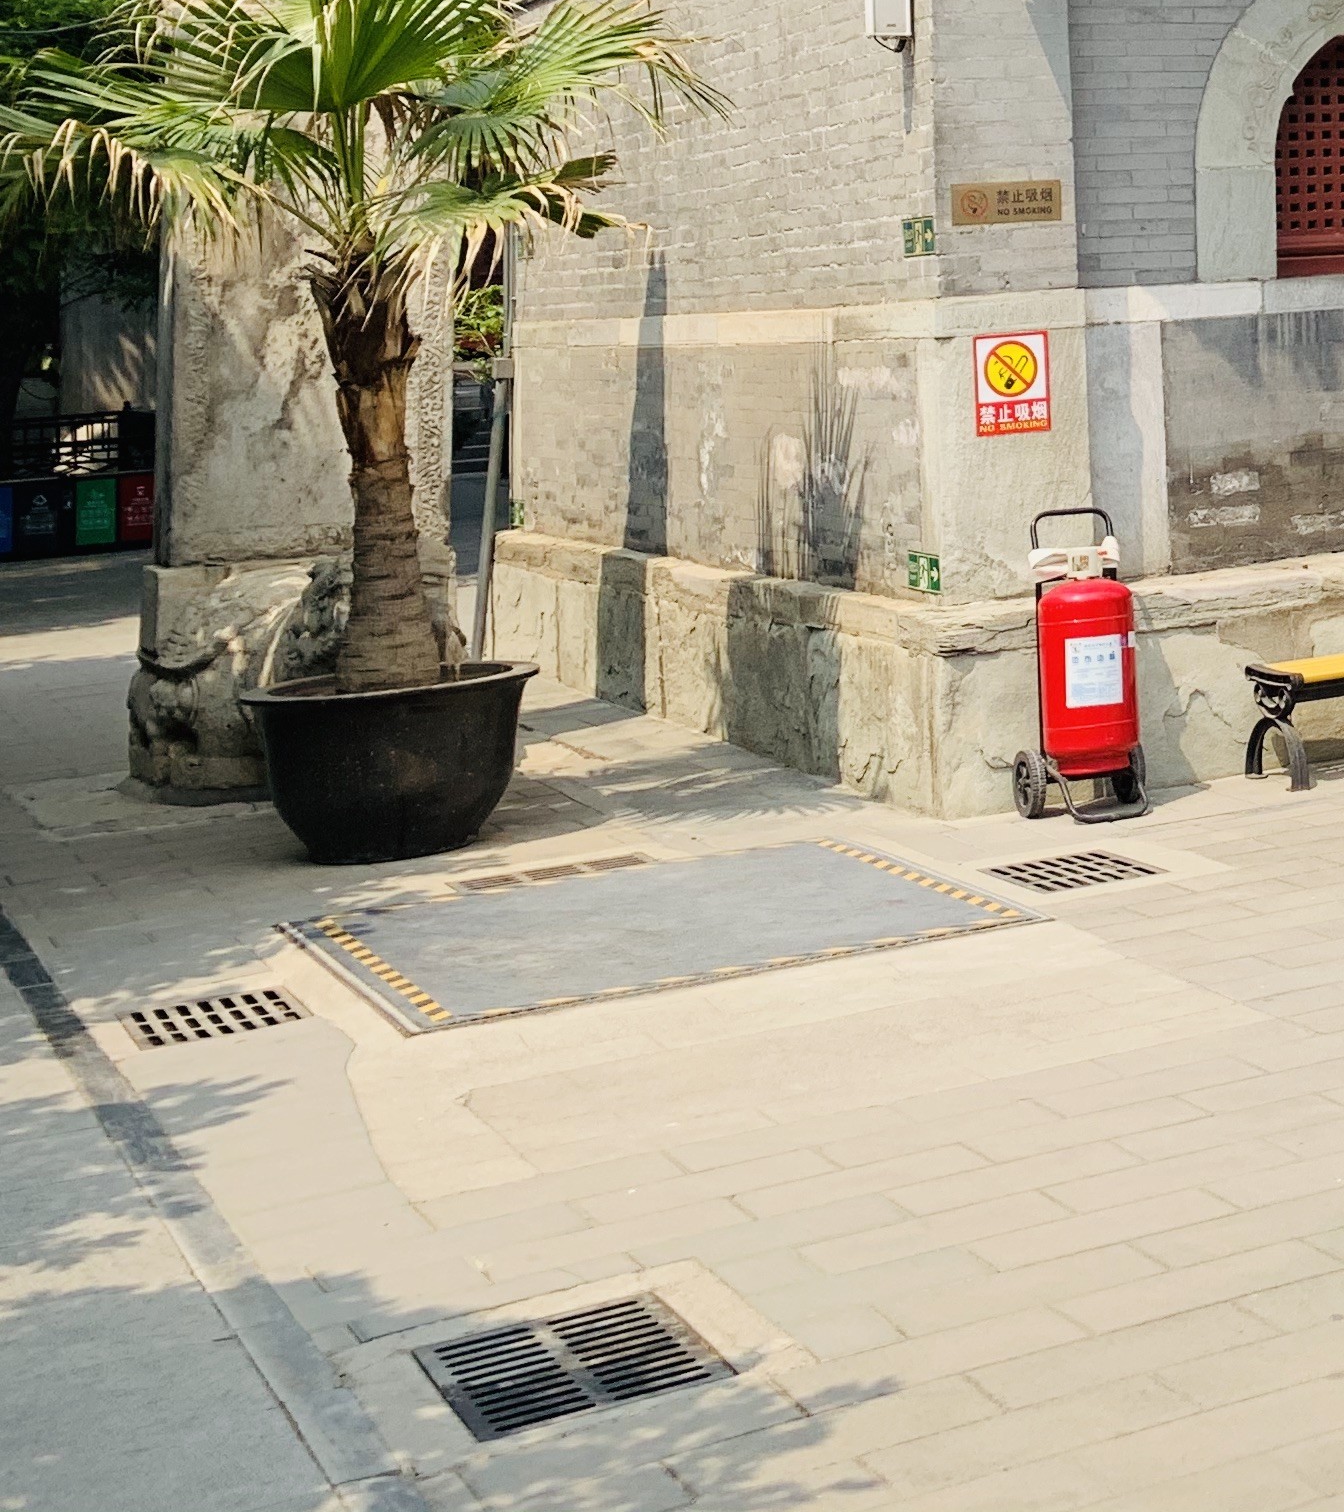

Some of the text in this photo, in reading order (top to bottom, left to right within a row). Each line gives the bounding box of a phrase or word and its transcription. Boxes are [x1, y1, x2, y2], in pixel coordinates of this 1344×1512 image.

[996, 188, 1053, 204] 禁止吸烟
[997, 206, 1053, 216] NO SMOKING
[979, 401, 1048, 425] 禁止吸烟
[979, 419, 1048, 433] NO SMOKING
